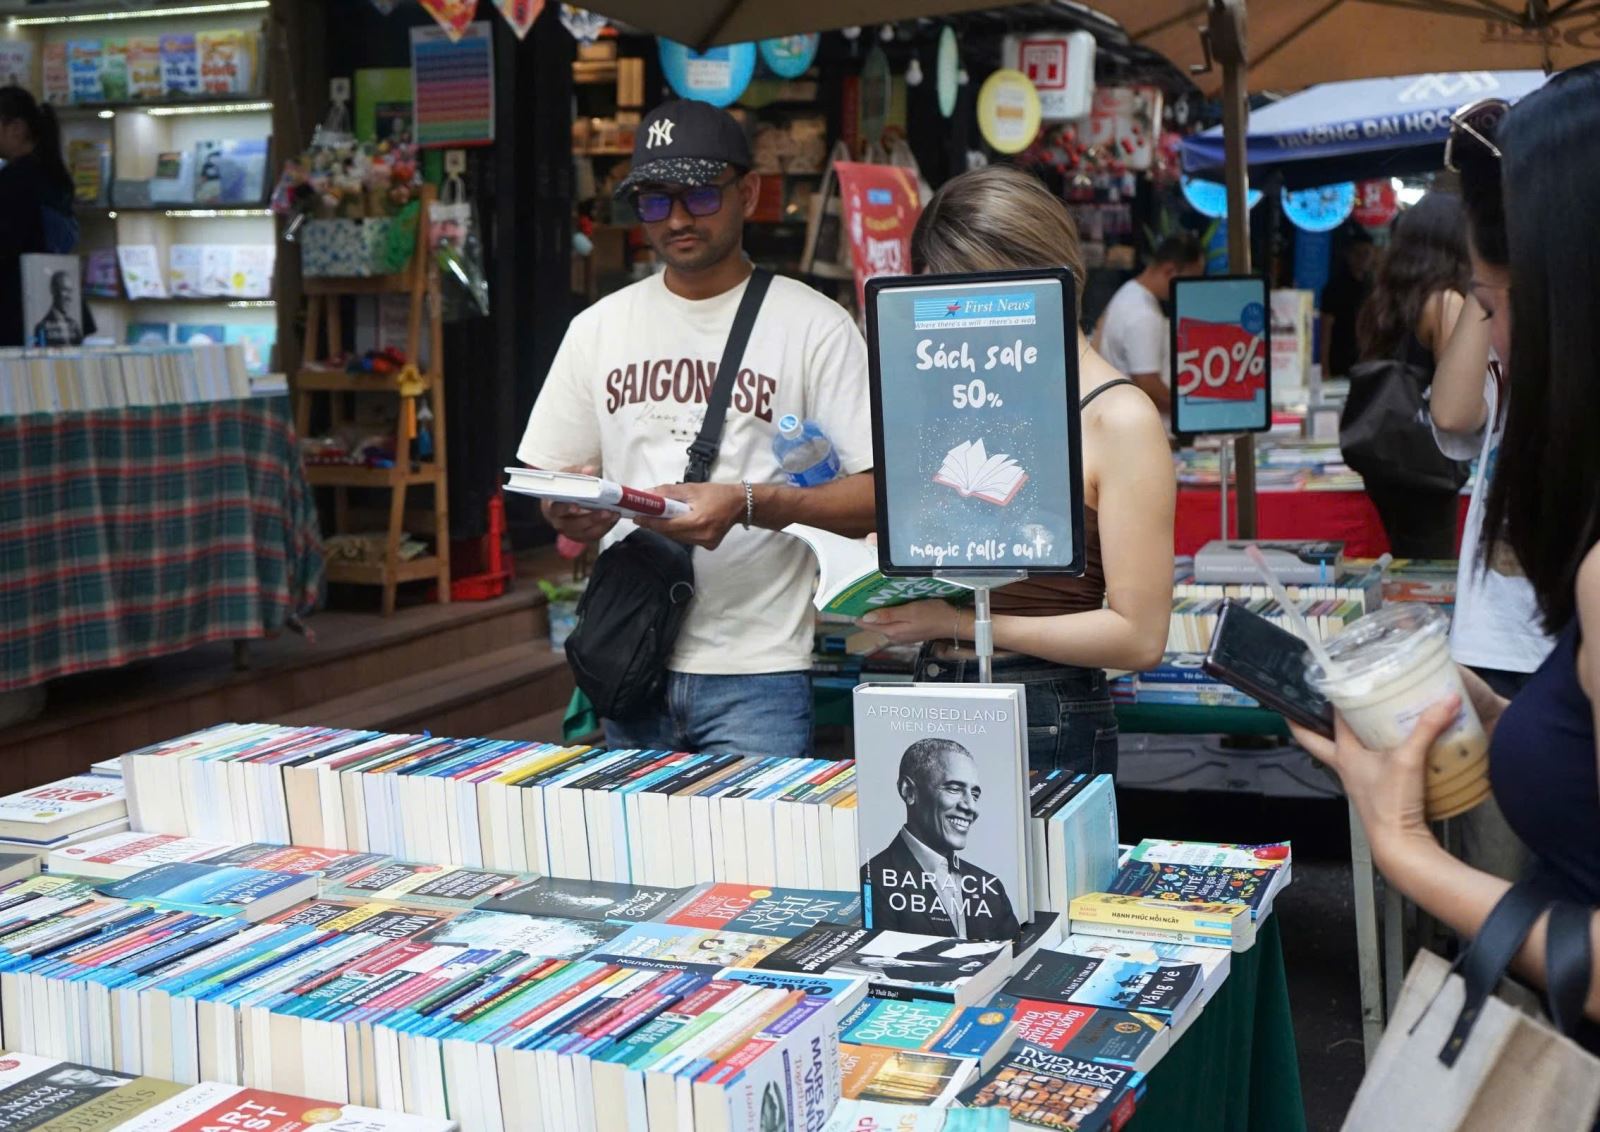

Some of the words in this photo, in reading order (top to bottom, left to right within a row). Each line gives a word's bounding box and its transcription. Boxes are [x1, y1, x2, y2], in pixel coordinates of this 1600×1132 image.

[1362, 118, 1401, 140] ĐẠI
[1405, 108, 1451, 133] HỌC
[965, 299, 993, 313] First
[997, 298, 1030, 311] News
[916, 339, 976, 373] Sách
[984, 339, 1038, 372] sale
[1177, 337, 1265, 396] 50%
[606, 358, 776, 423] SAIGONSE
[952, 379, 1003, 409] 50%
[910, 540, 960, 566] magic
[965, 540, 1005, 561] falls
[866, 705, 877, 717] A
[879, 705, 960, 720] PROMISED
[963, 709, 1008, 722] LAND
[882, 868, 999, 895] BARACK
[715, 898, 752, 919] BIG
[888, 892, 993, 918] OBAMA
[380, 915, 437, 939] MAYB
[1177, 933, 1183, 942] 8
[746, 974, 800, 984] Edward
[811, 1036, 824, 1104] MARS
[804, 1067, 815, 1132] VENU
